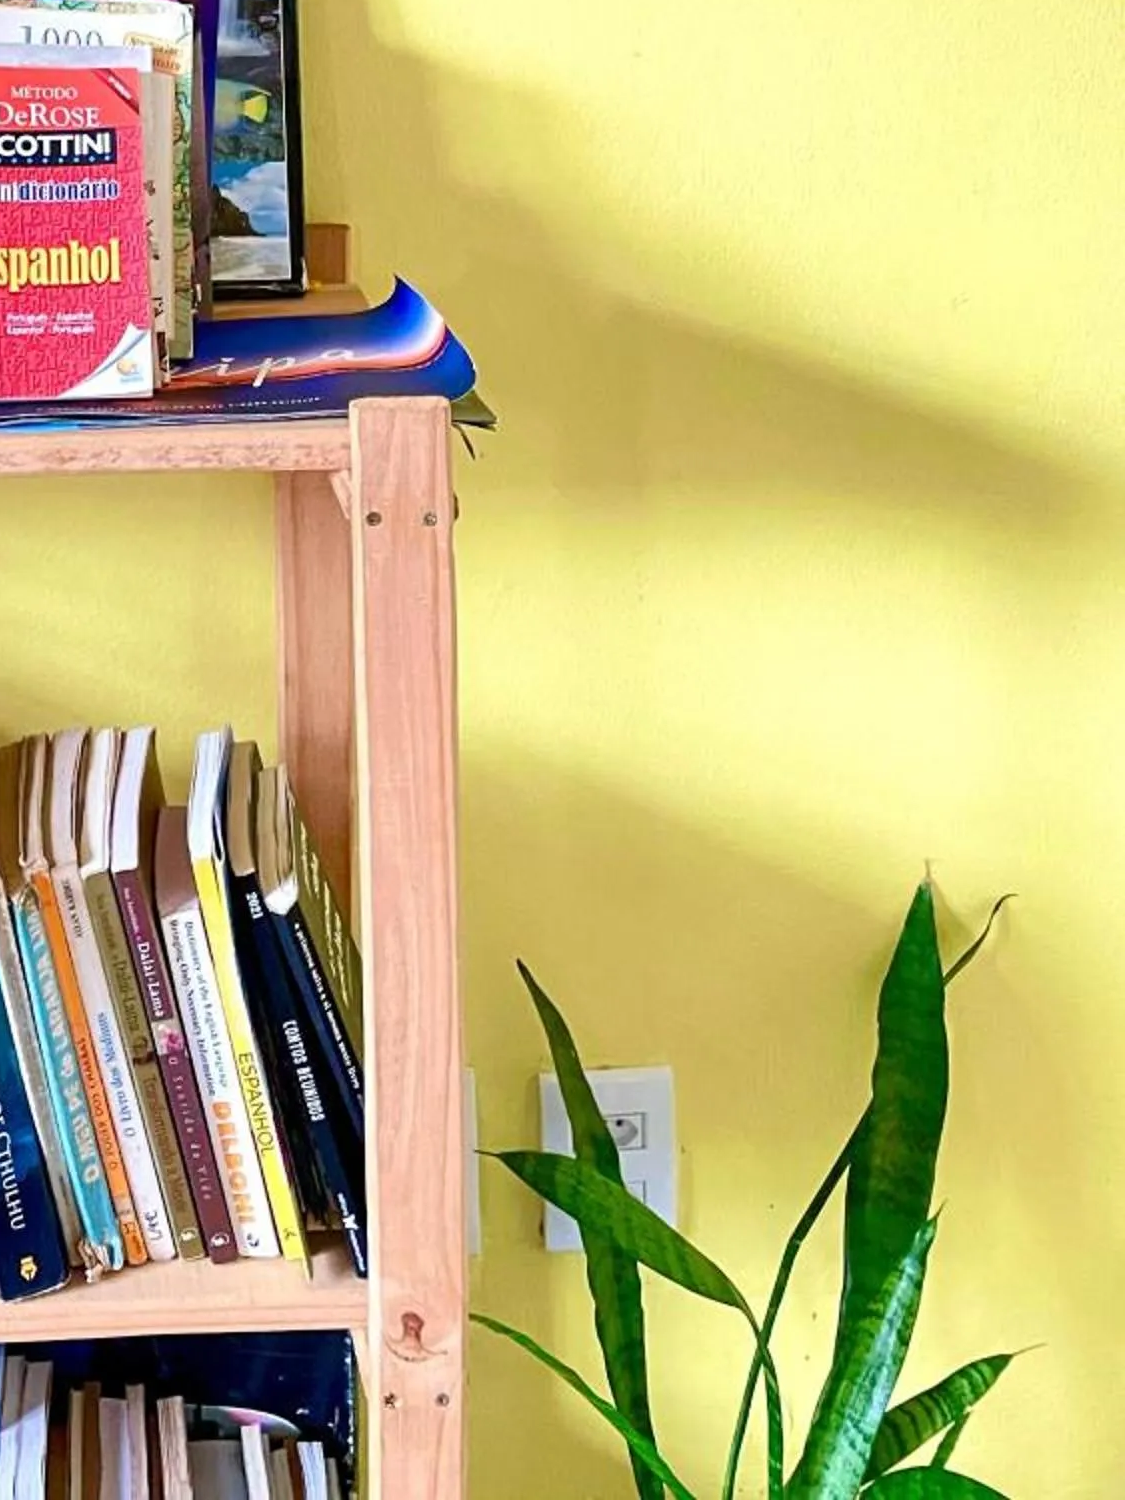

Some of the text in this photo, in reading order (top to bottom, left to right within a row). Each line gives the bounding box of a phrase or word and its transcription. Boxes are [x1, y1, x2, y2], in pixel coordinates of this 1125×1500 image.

[10, 85, 78, 100] MÉTODO
[135, 941, 167, 1018] Dalai-Lama
[175, 962, 192, 987] Only
[194, 1037, 217, 1097] Information
[107, 1066, 122, 1090] dos
[281, 1018, 326, 1123] CONTOS REUNIDOS
[113, 1089, 132, 1123] Livro
[237, 1050, 275, 1157] ESPANHOL
[72, 1114, 95, 1159] MEU
[123, 1126, 136, 1138] O
[83, 1164, 100, 1183] O
